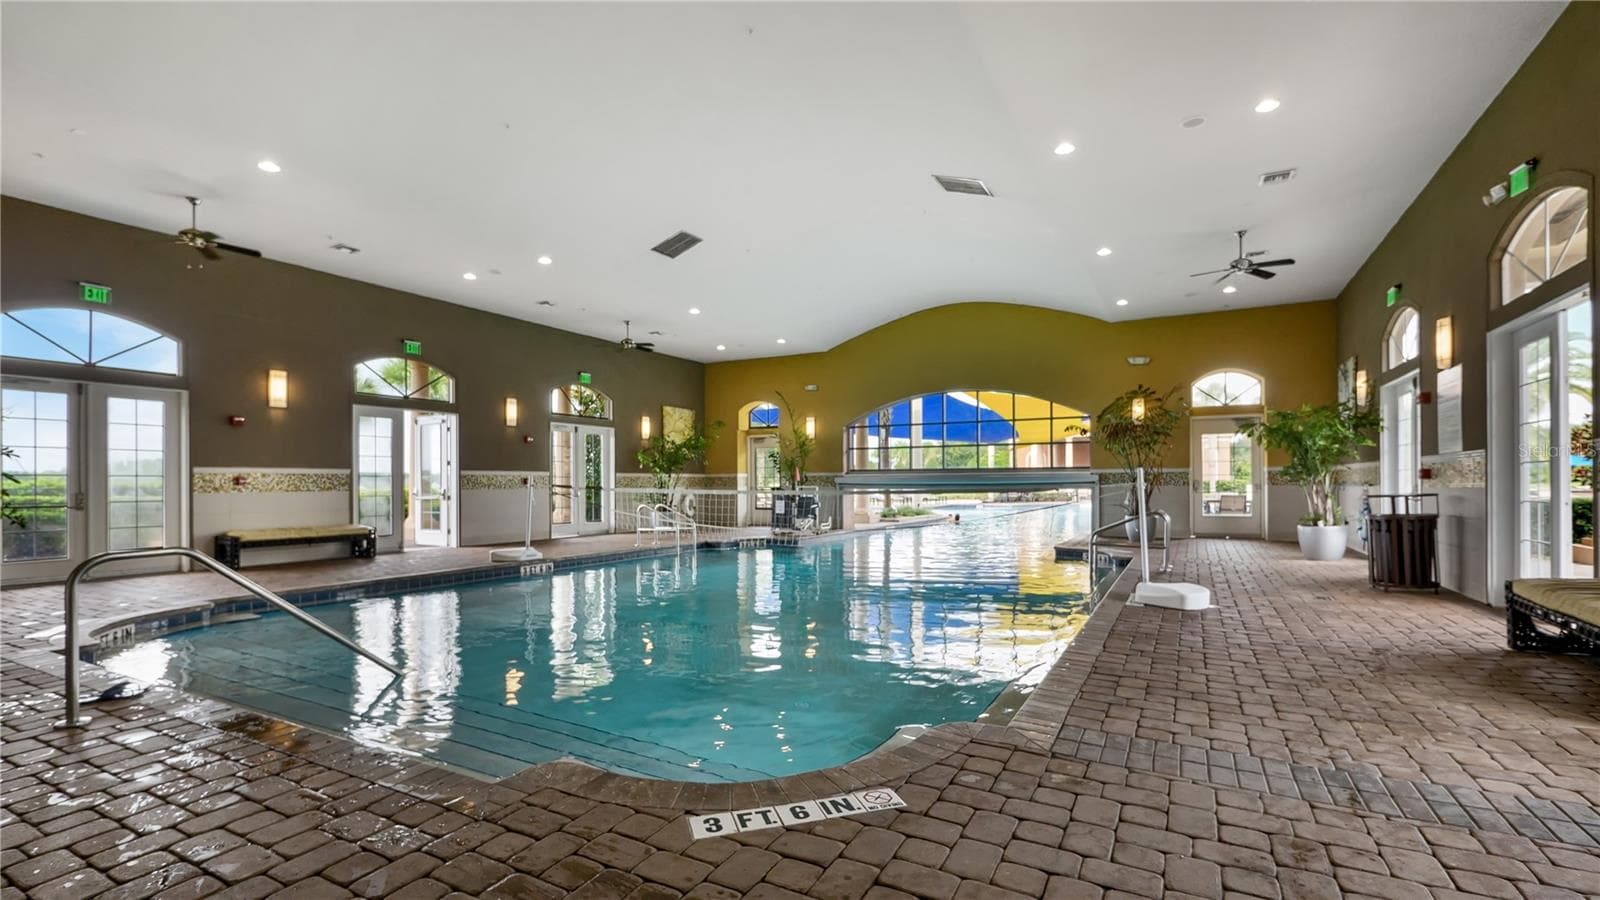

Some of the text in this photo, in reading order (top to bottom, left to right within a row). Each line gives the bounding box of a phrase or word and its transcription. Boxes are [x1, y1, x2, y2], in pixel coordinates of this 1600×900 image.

[85, 286, 107, 303] EXIT
[703, 797, 862, 833] 3 FT. 6 IN.
